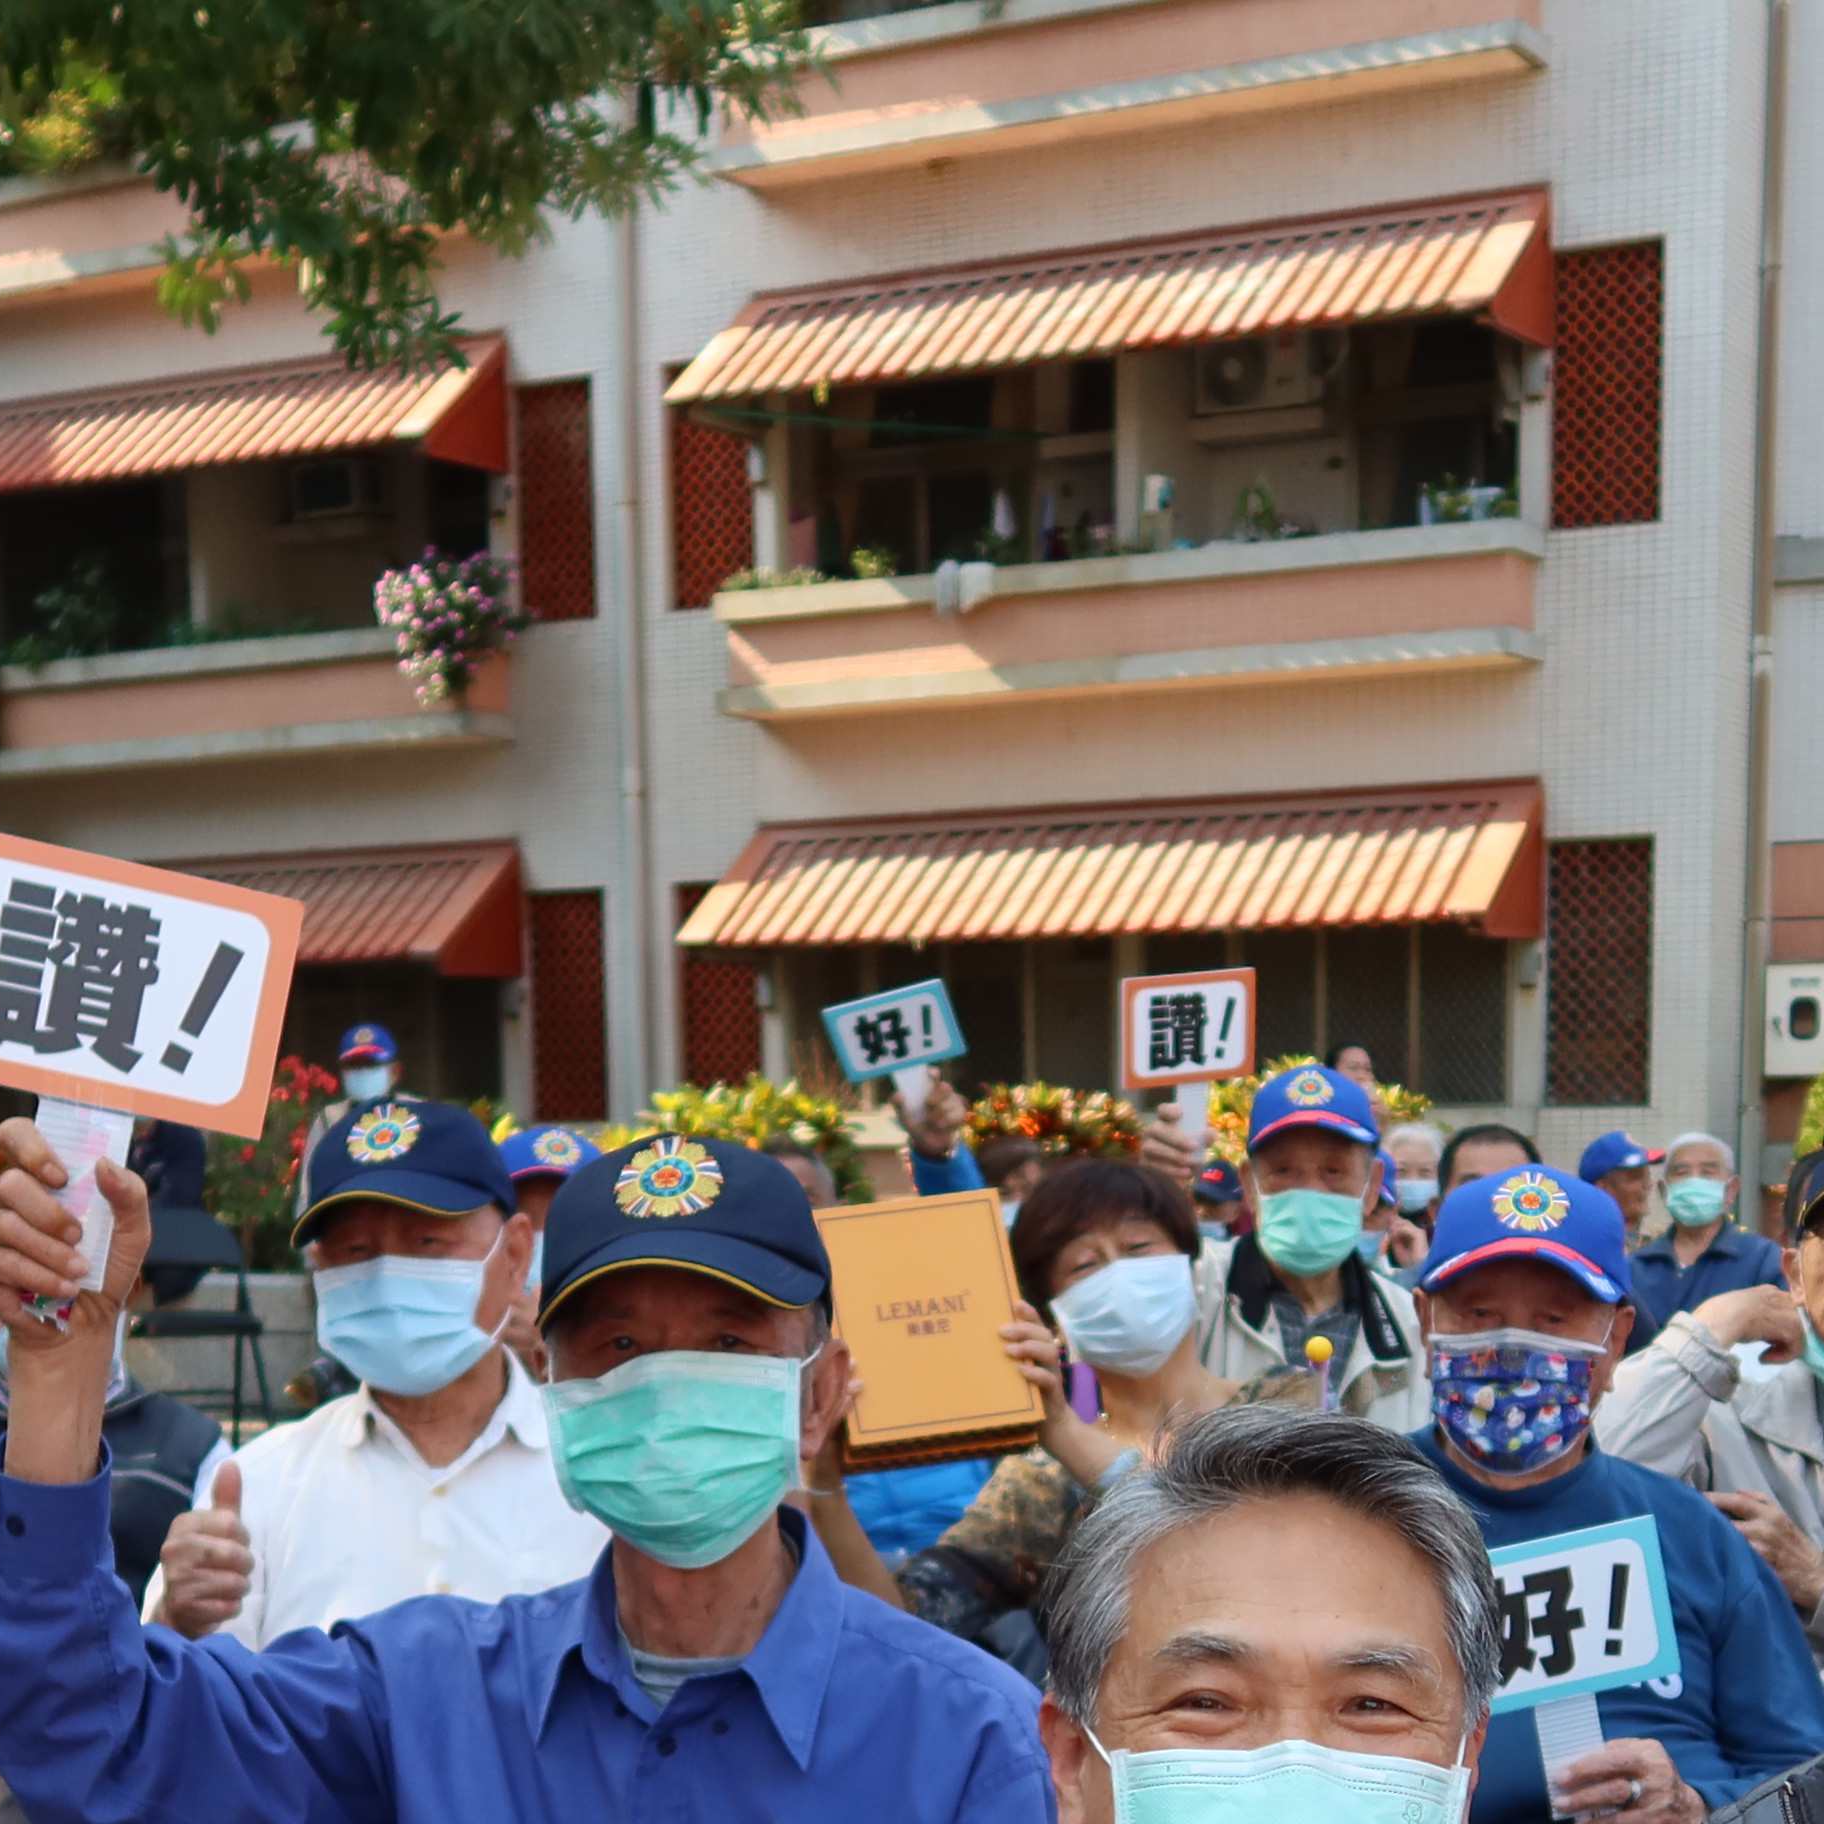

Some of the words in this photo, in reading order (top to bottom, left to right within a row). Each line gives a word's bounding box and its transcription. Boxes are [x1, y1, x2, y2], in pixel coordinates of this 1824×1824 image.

[853, 1003, 934, 1065] 好!
[1149, 991, 1237, 1072] 讚!
[1493, 1563, 1631, 1688] 好!
